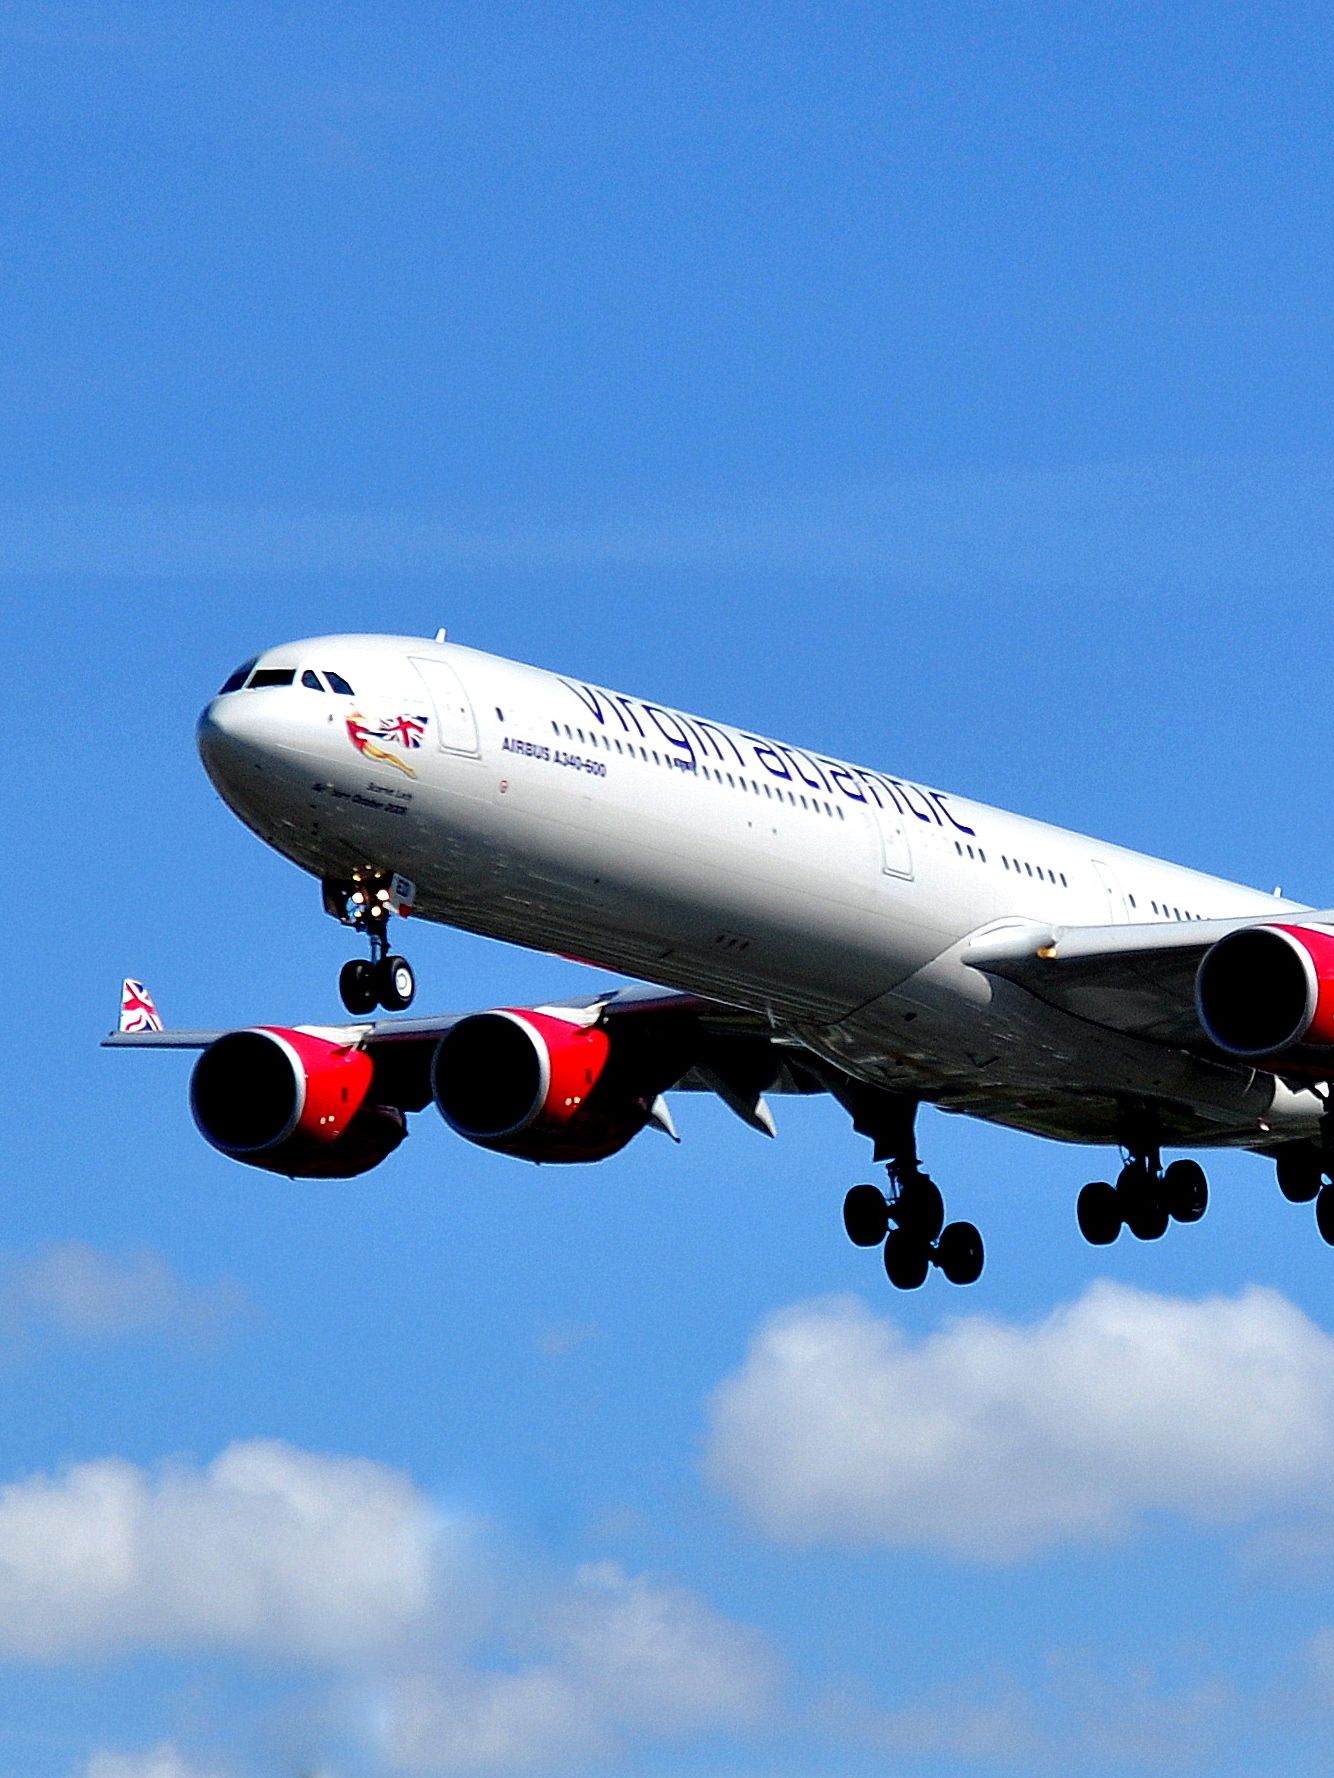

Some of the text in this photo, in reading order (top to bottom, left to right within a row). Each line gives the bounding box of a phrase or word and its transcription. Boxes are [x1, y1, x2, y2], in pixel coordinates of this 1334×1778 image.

[502, 737, 607, 778] AIRBUS A340-600
[558, 679, 976, 837] virgin atlantic
